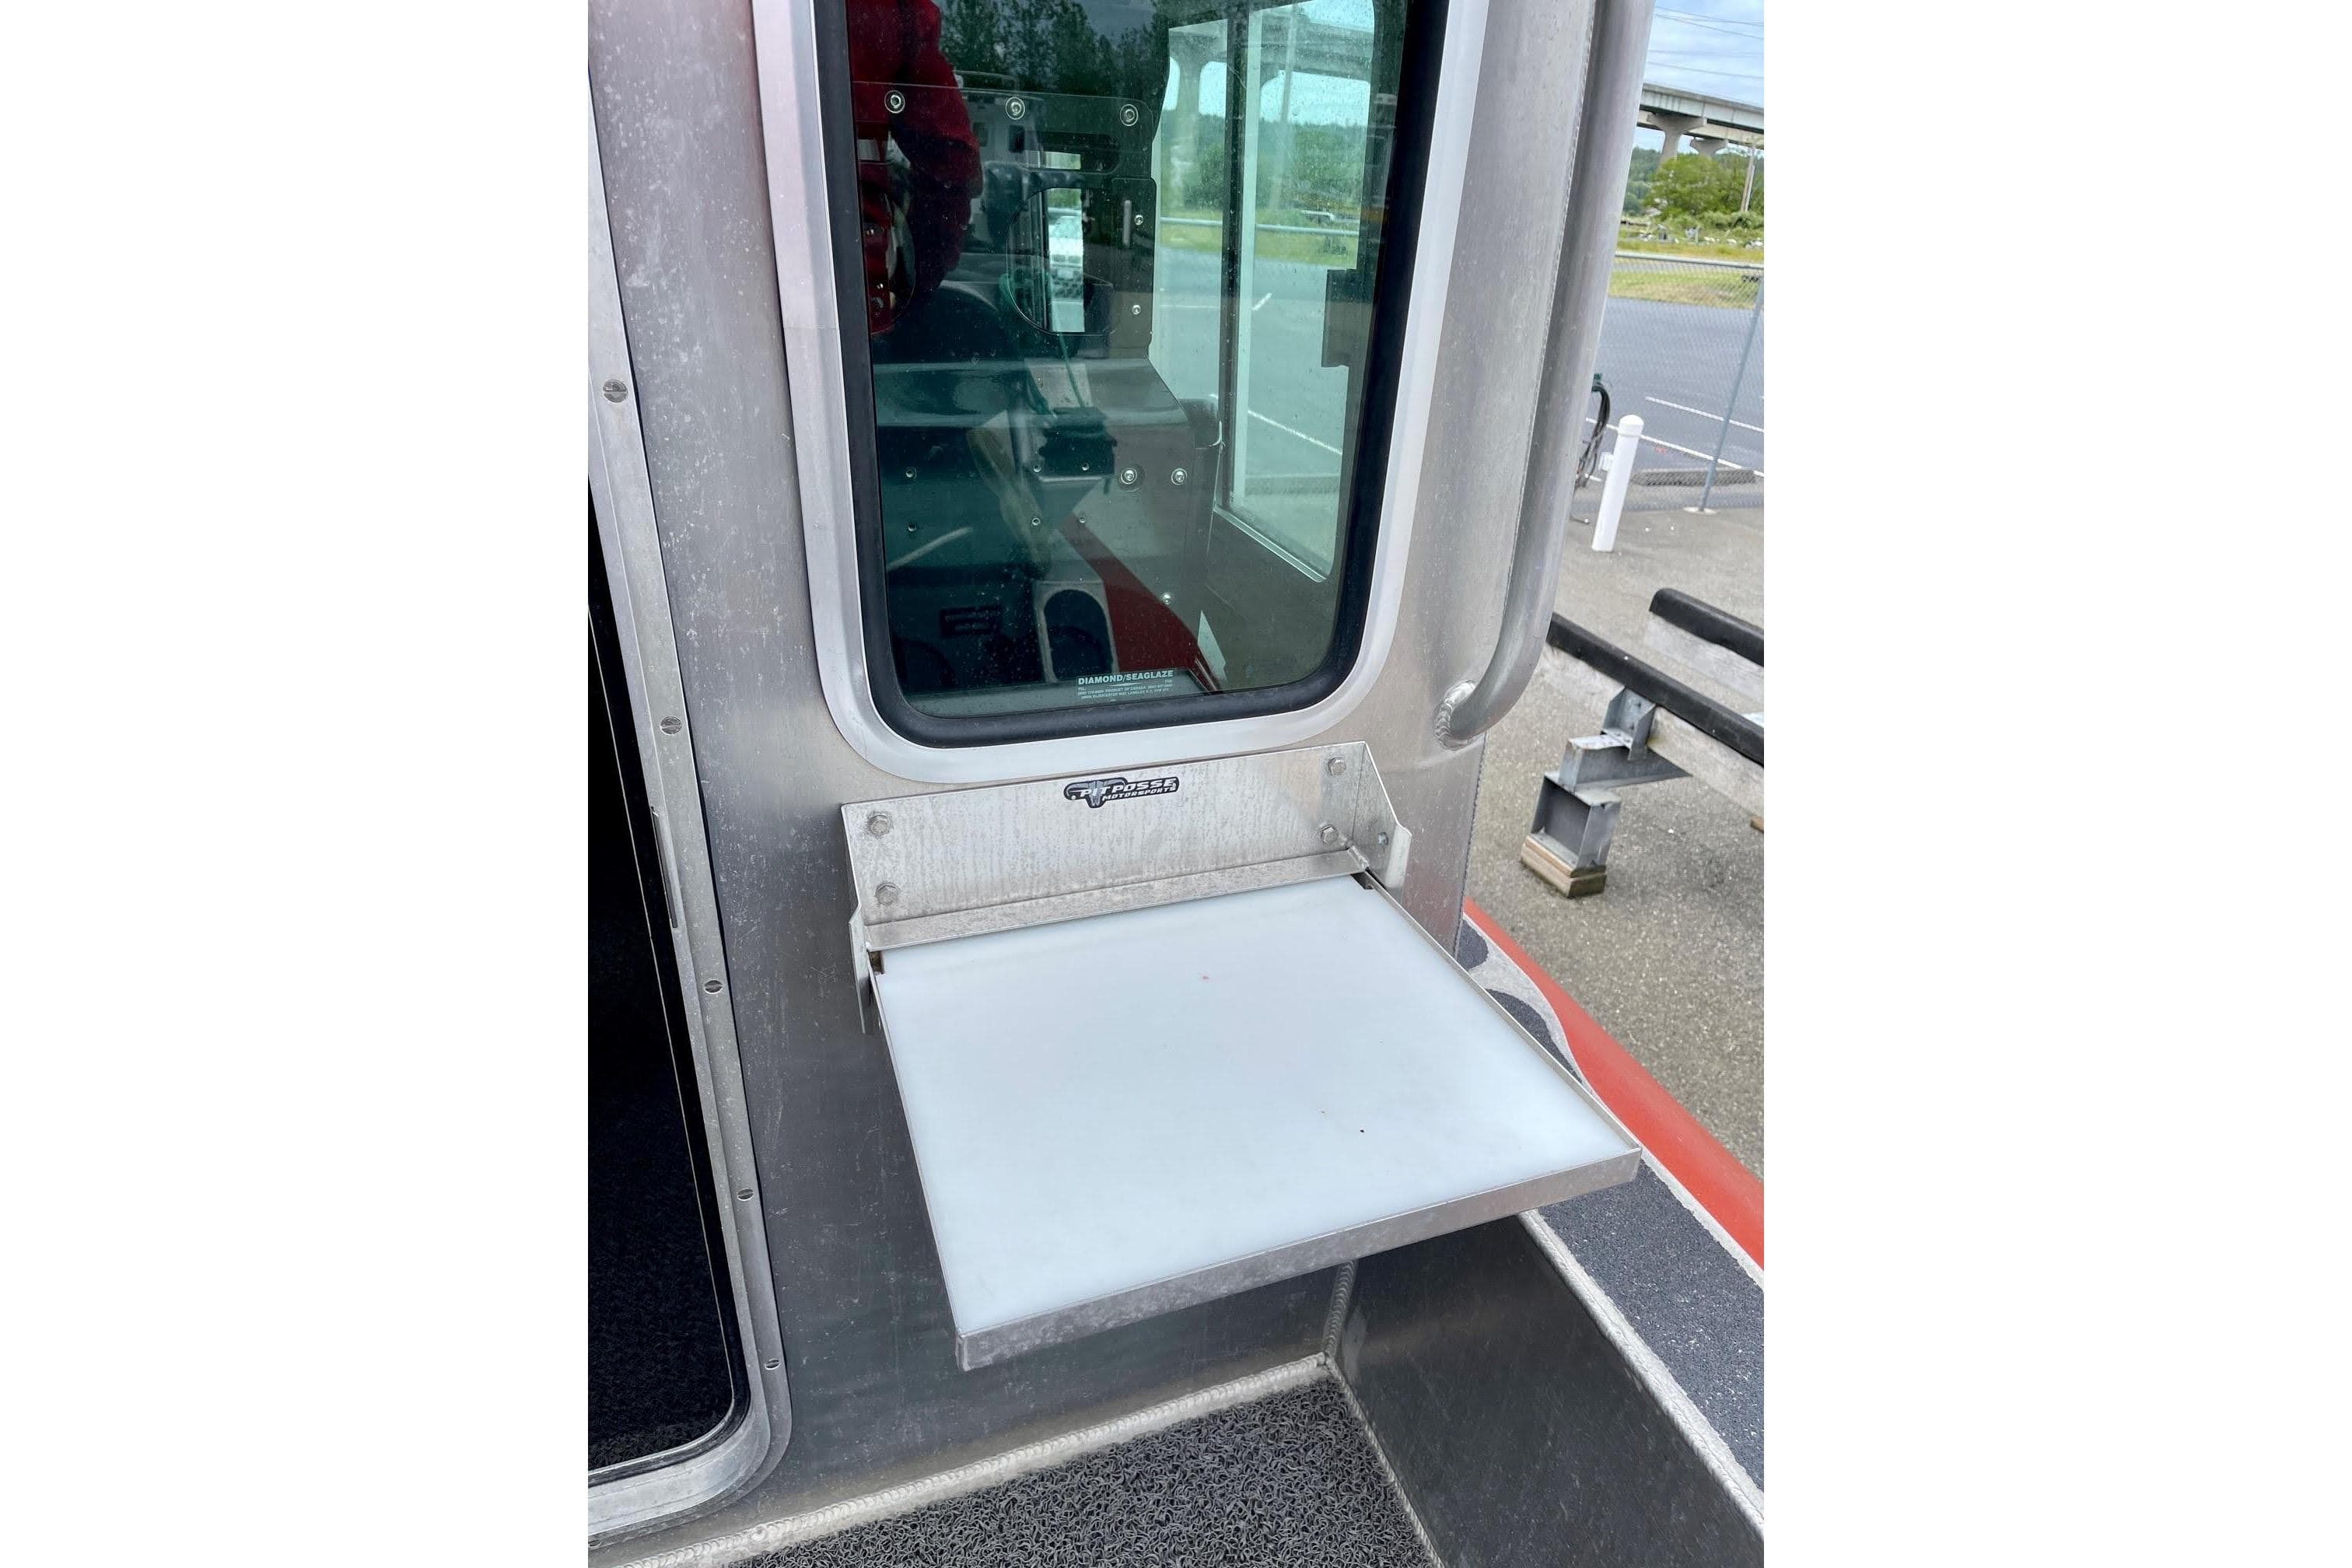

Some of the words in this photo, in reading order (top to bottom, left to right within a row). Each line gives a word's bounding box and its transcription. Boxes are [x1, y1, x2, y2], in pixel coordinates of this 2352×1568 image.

[1078, 670, 1174, 685] DIAMOND/SEAGLAZE
[1080, 786, 1111, 797] PIT
[1112, 778, 1177, 793] POSSE
[1101, 786, 1177, 801] MOTORSPORTS
